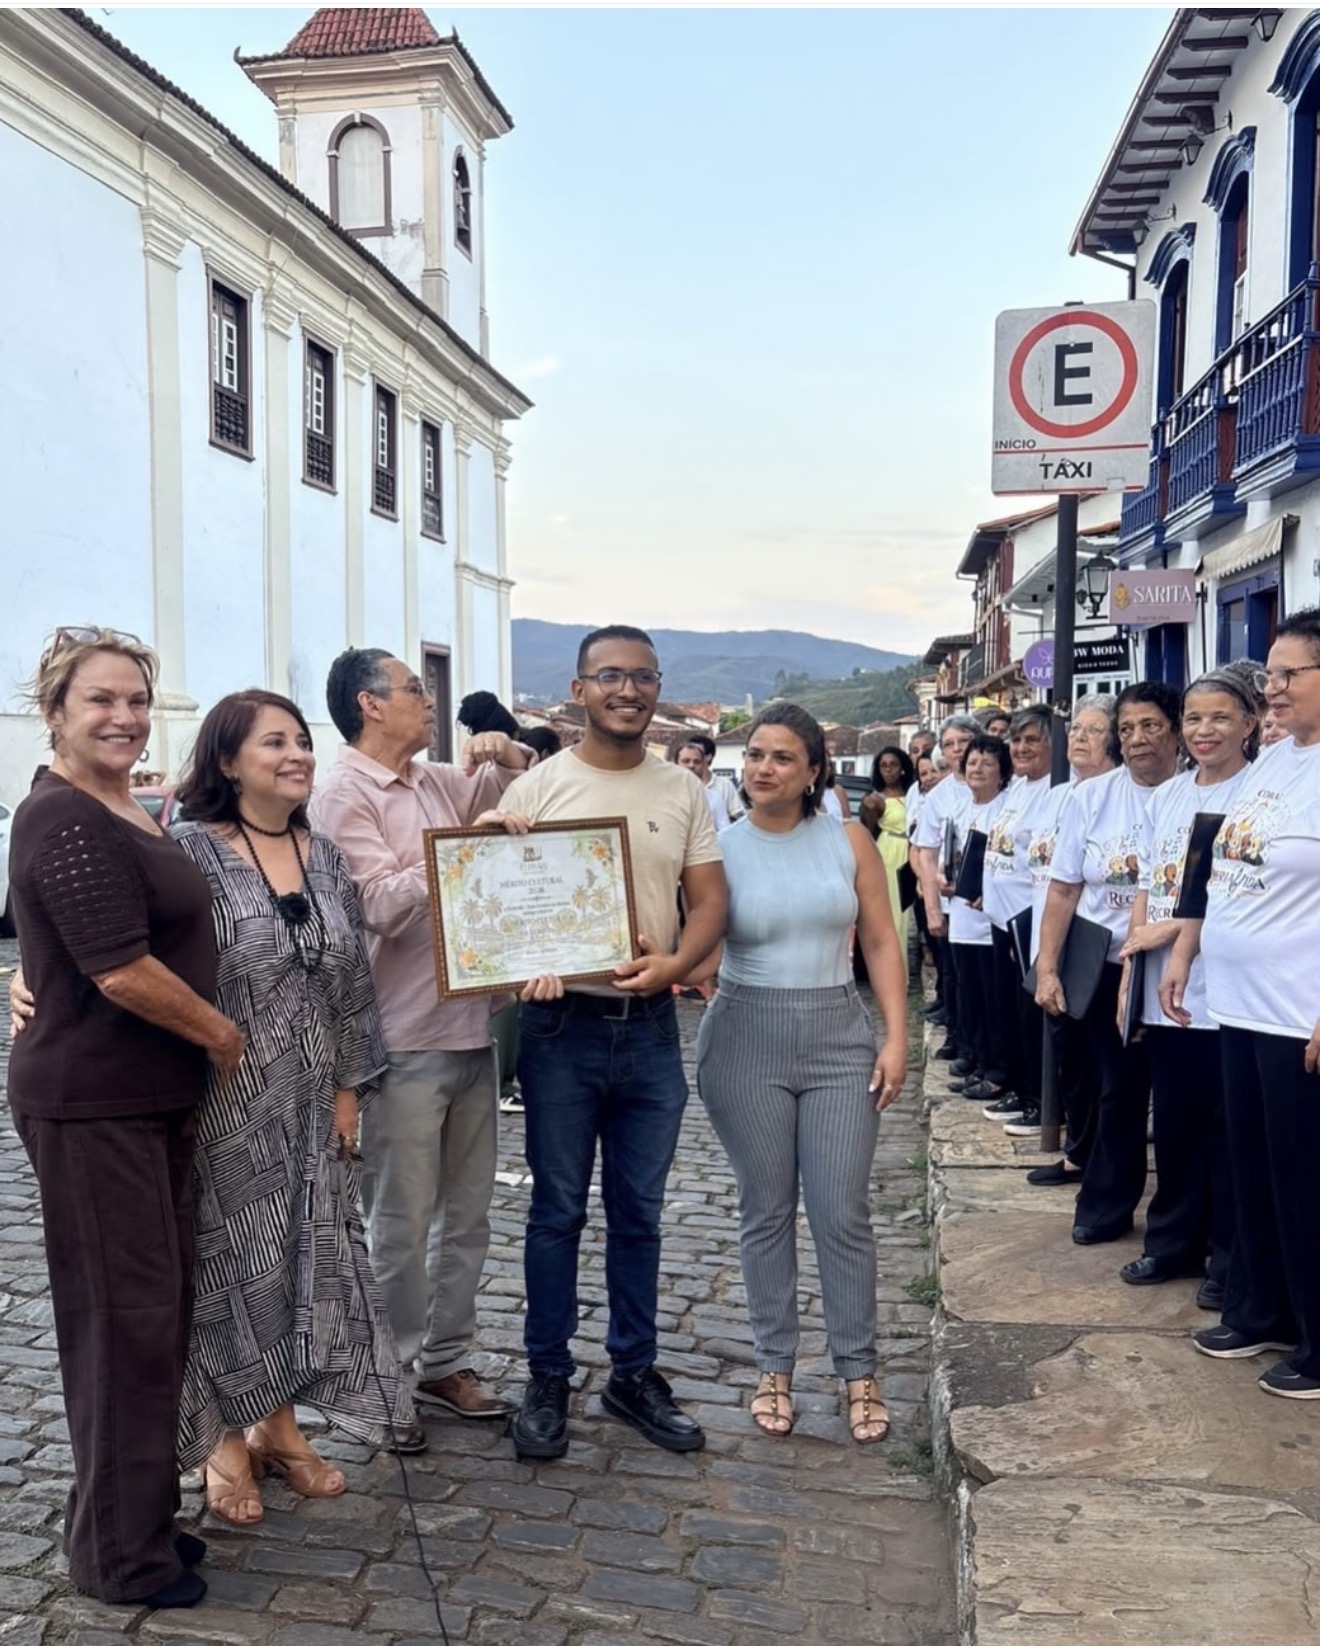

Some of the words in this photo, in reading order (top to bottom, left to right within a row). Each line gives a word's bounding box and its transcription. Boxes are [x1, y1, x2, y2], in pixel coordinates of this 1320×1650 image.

[1054, 342, 1093, 406] E
[995, 438, 1037, 449] INÍCIO
[1039, 457, 1093, 479] TÁXI
[1133, 584, 1192, 603] SARITA
[1091, 644, 1125, 656] MODA
